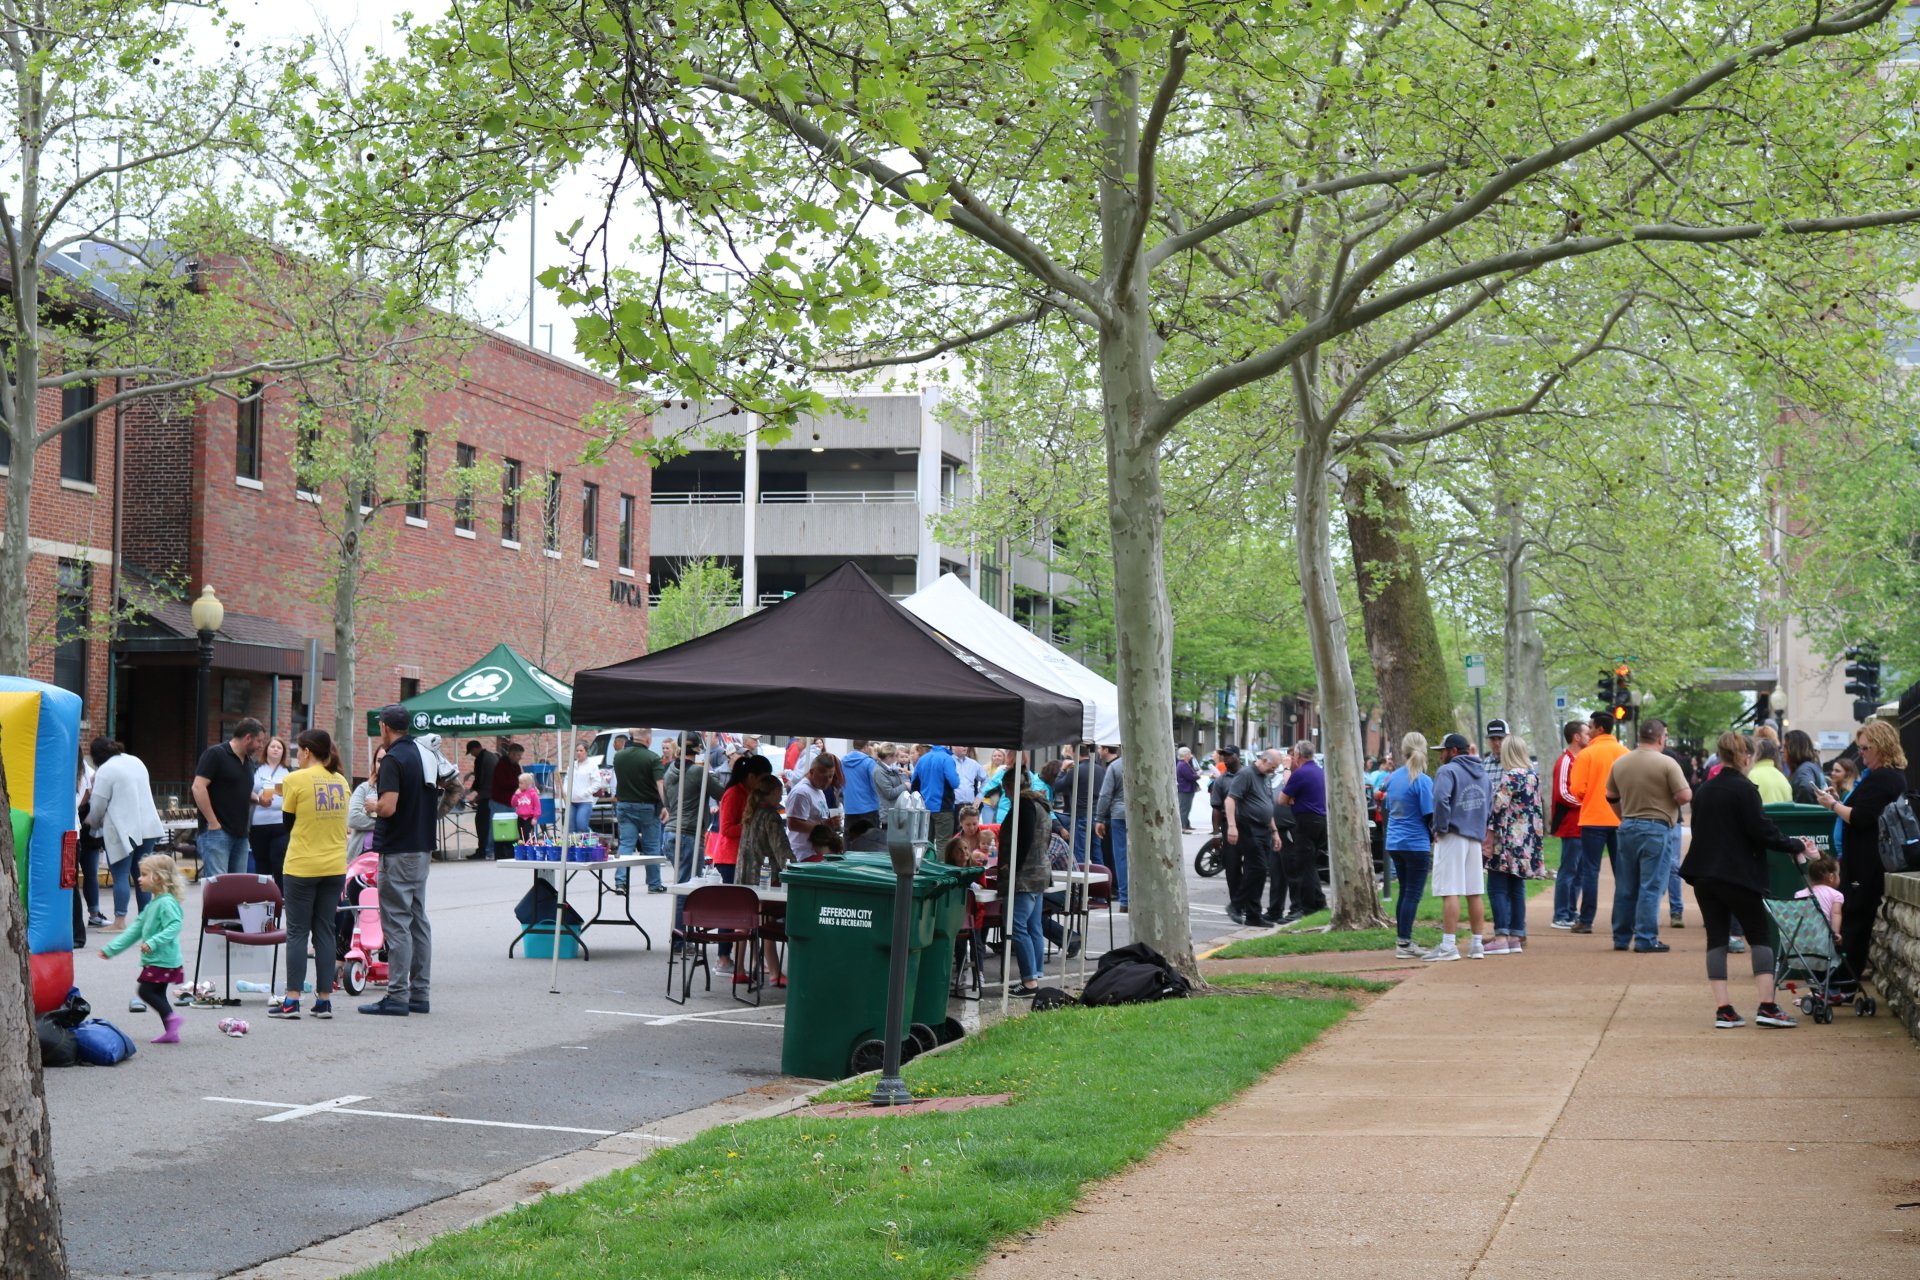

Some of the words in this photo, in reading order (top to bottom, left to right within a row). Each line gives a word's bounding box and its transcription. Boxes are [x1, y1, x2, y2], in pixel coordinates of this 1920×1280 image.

[433, 713, 477, 726] Central
[479, 711, 511, 724] Bank
[1815, 835, 1829, 843] CITY
[819, 906, 857, 918] JEFFERSON
[857, 909, 872, 920] CITY
[819, 916, 835, 925] PARKS
[835, 918, 840, 926] &
[840, 918, 872, 928] RECREATION
